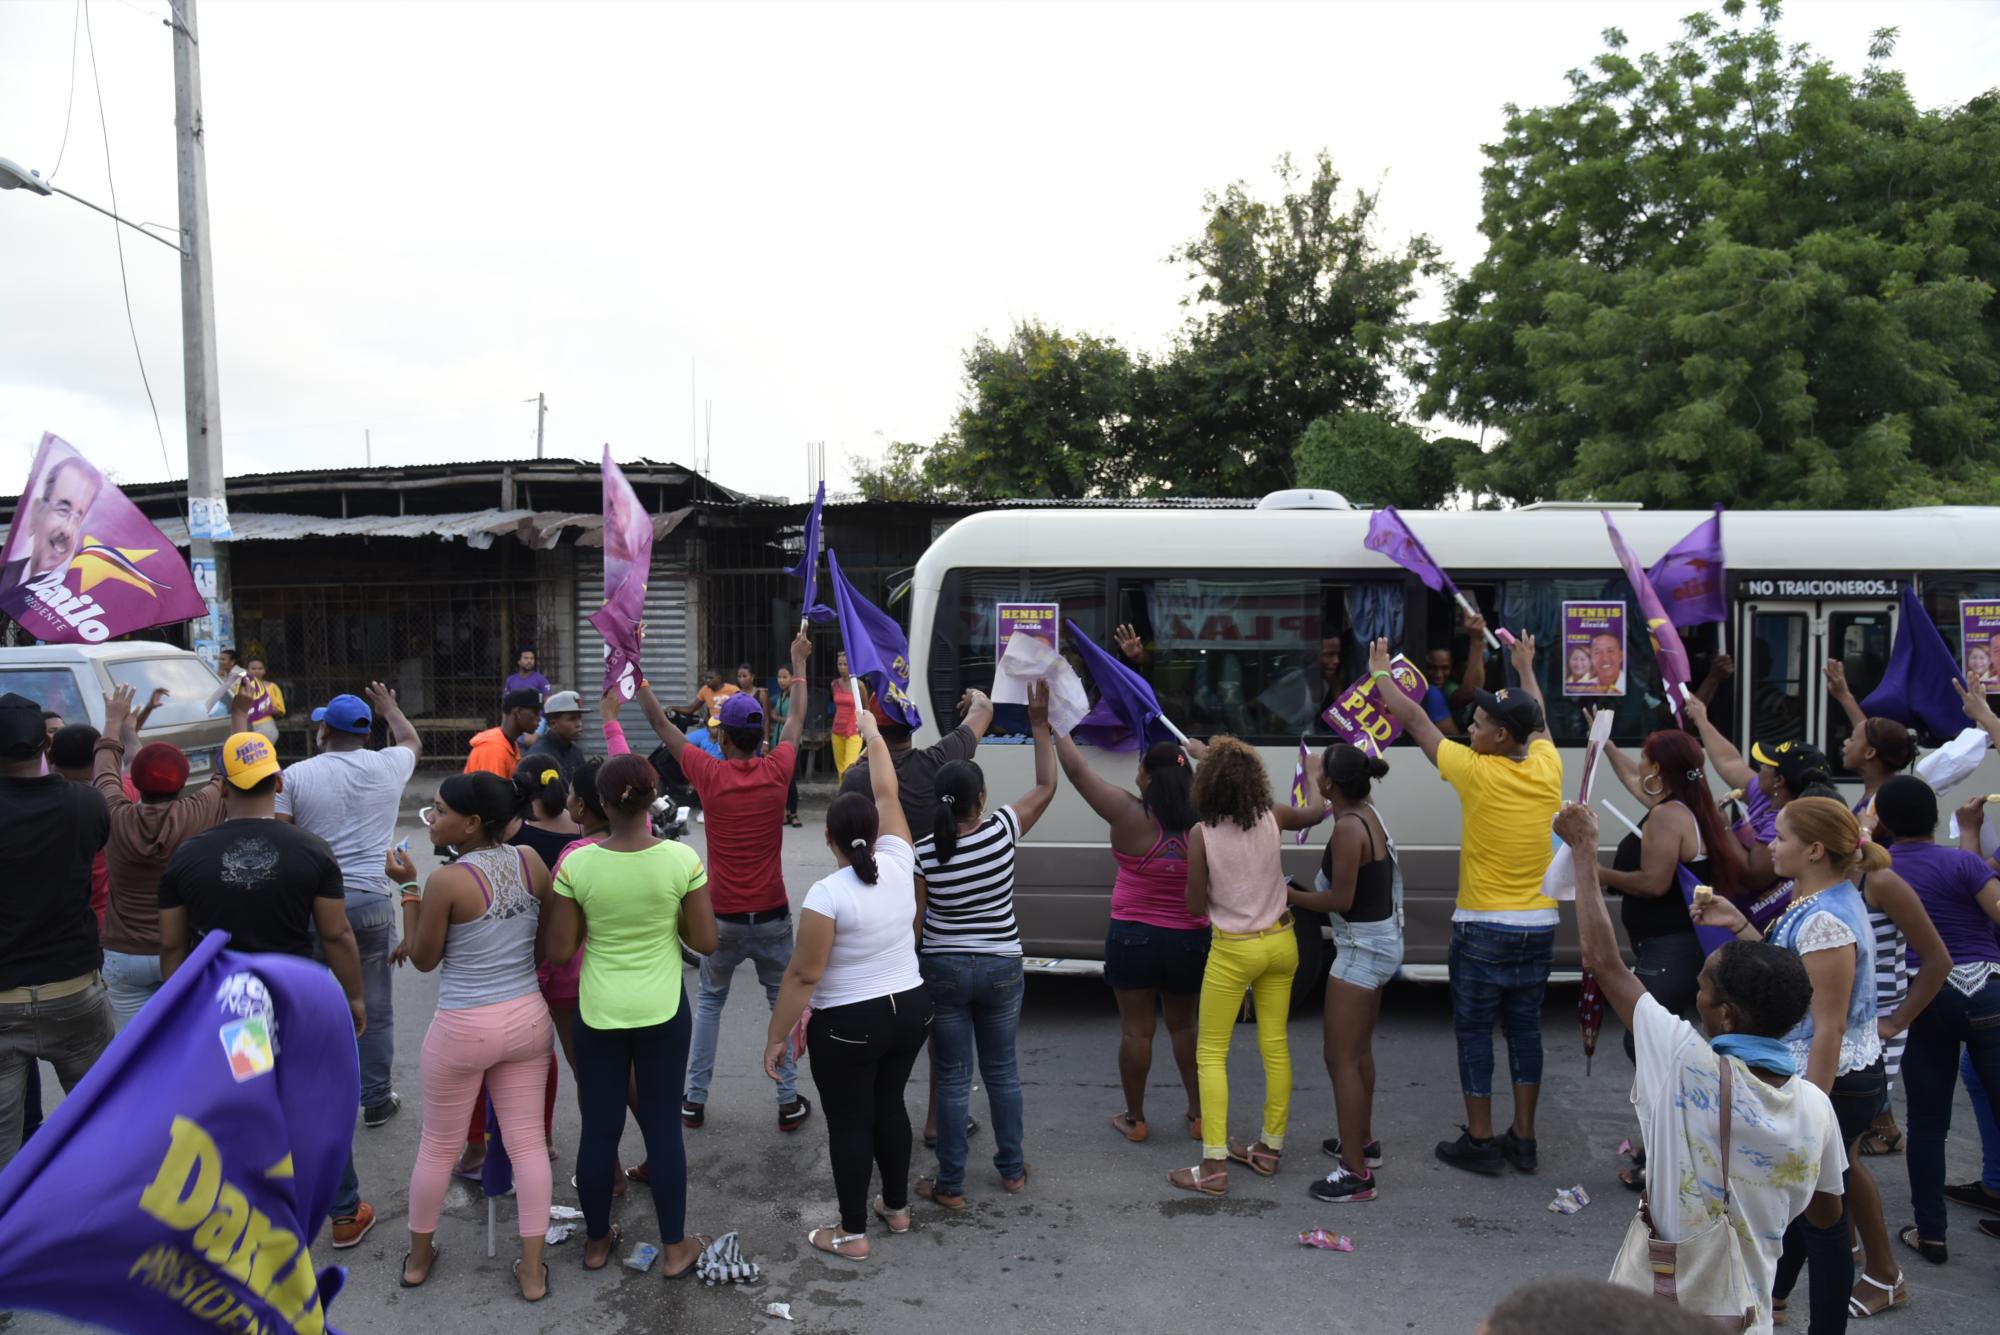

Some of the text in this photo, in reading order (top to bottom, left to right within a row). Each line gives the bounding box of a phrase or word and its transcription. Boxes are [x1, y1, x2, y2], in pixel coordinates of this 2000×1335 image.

[1750, 580, 1774, 595] NO
[1001, 609, 1054, 620] HENRIS
[1567, 607, 1622, 618] HENRIS
[1341, 690, 1393, 741] PLD
